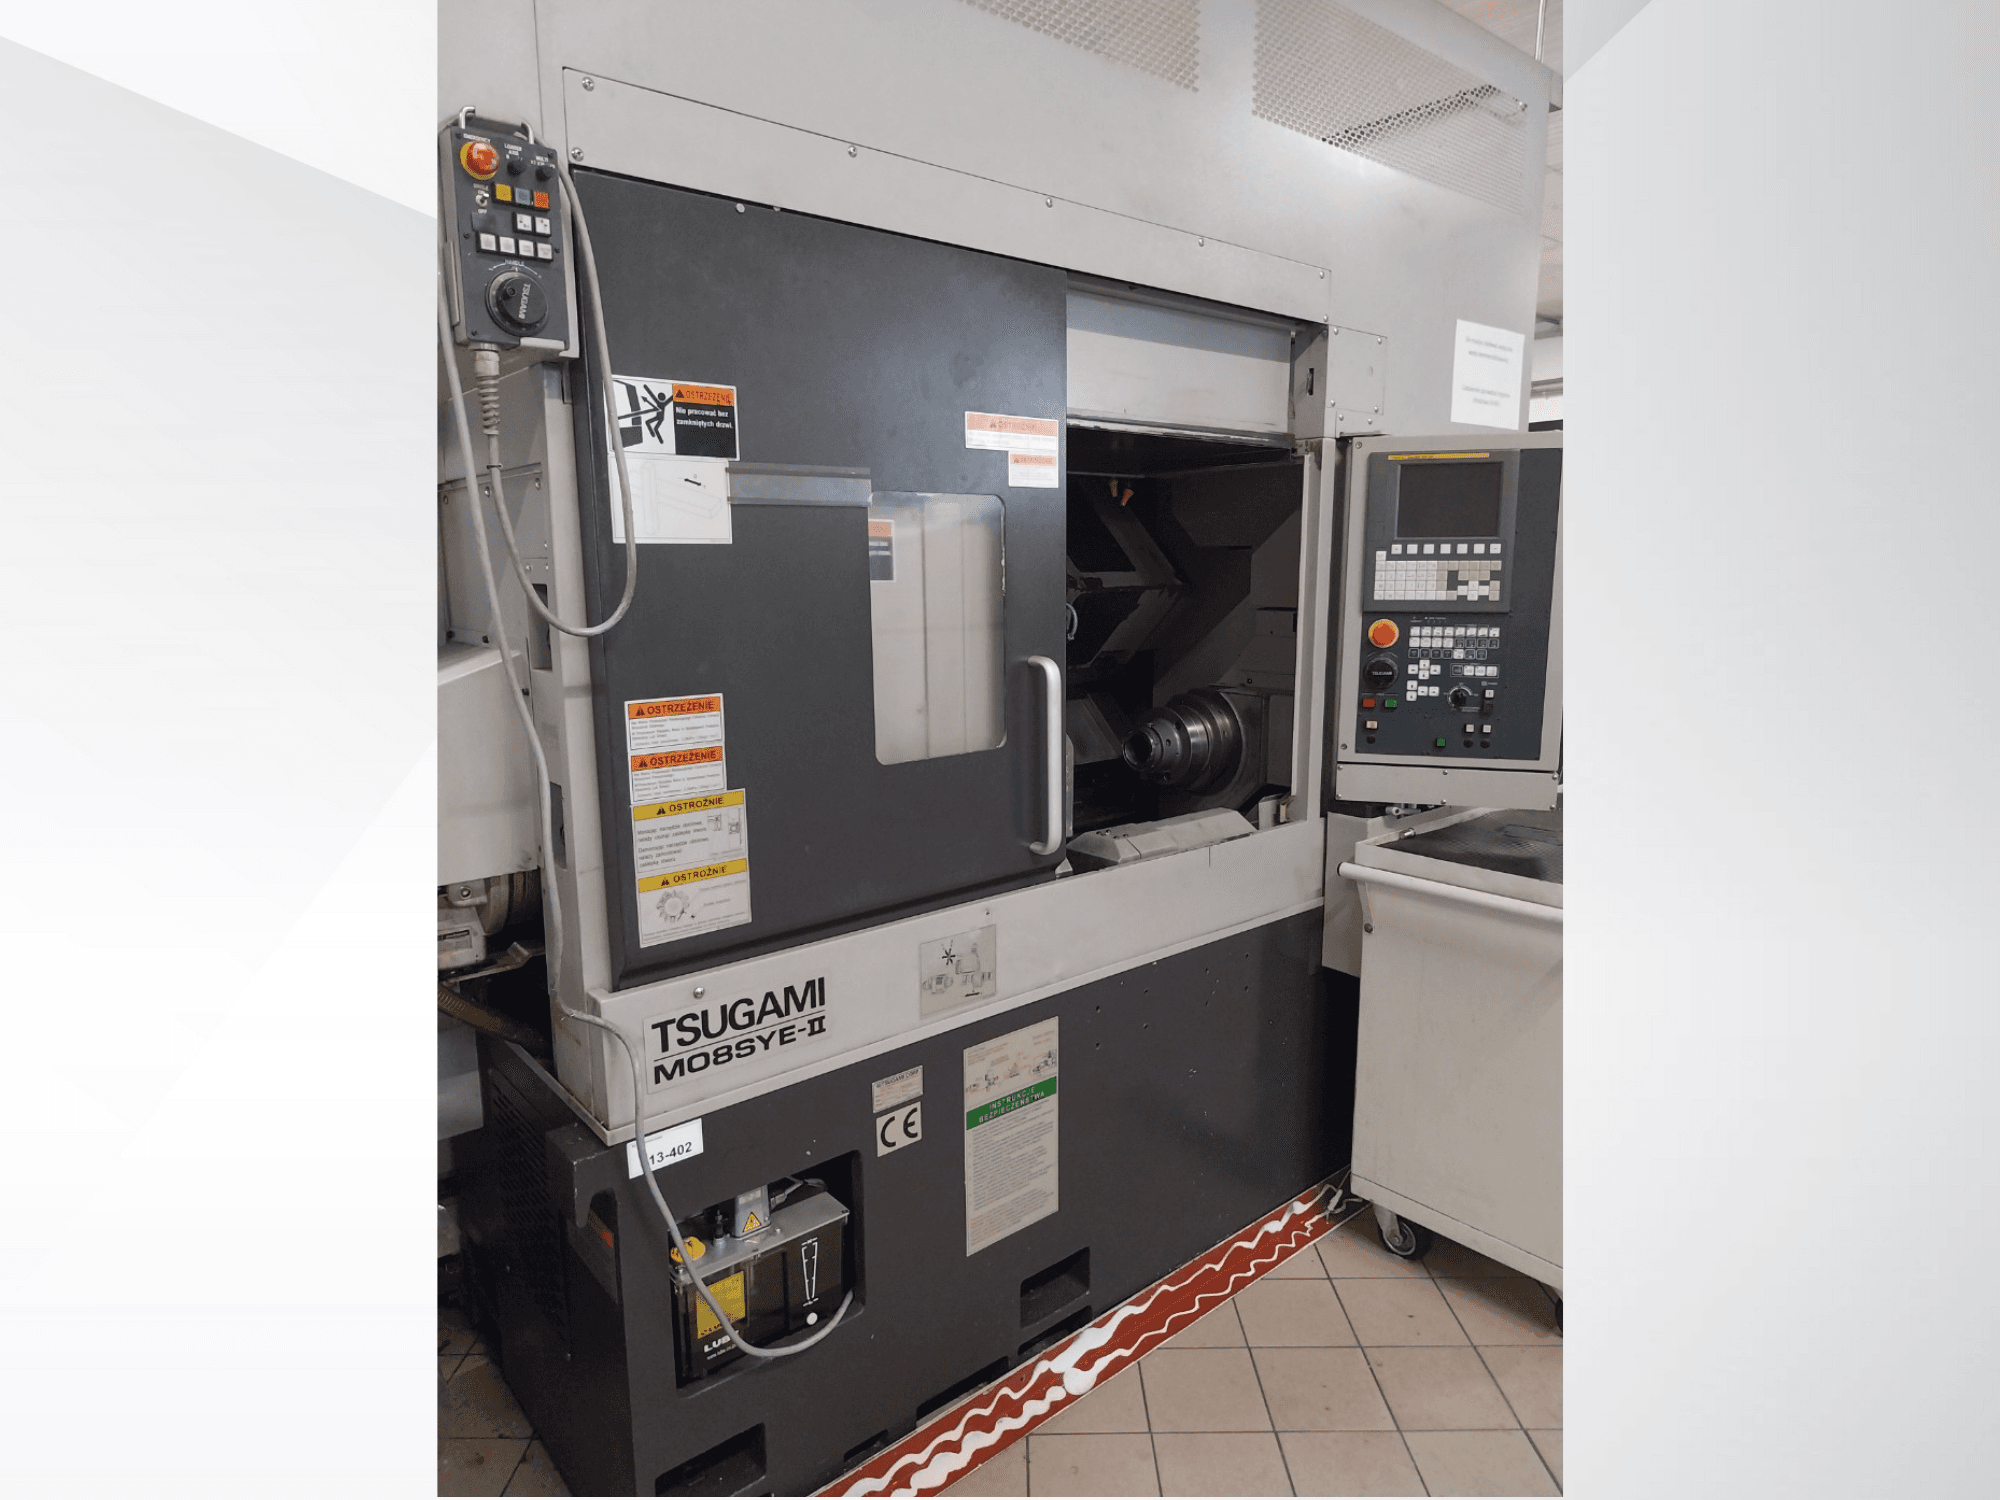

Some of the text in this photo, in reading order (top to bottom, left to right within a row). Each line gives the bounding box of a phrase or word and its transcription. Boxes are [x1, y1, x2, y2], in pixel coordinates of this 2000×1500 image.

[518, 283, 531, 320] TSUGAMI
[675, 406, 687, 414] Nie
[687, 409, 717, 417] pracować
[676, 418, 715, 429] zamkniętych
[651, 976, 826, 1053] TSUGAMI
[989, 1086, 1036, 1110] INSTRUKCJE
[880, 1107, 918, 1148] CE
